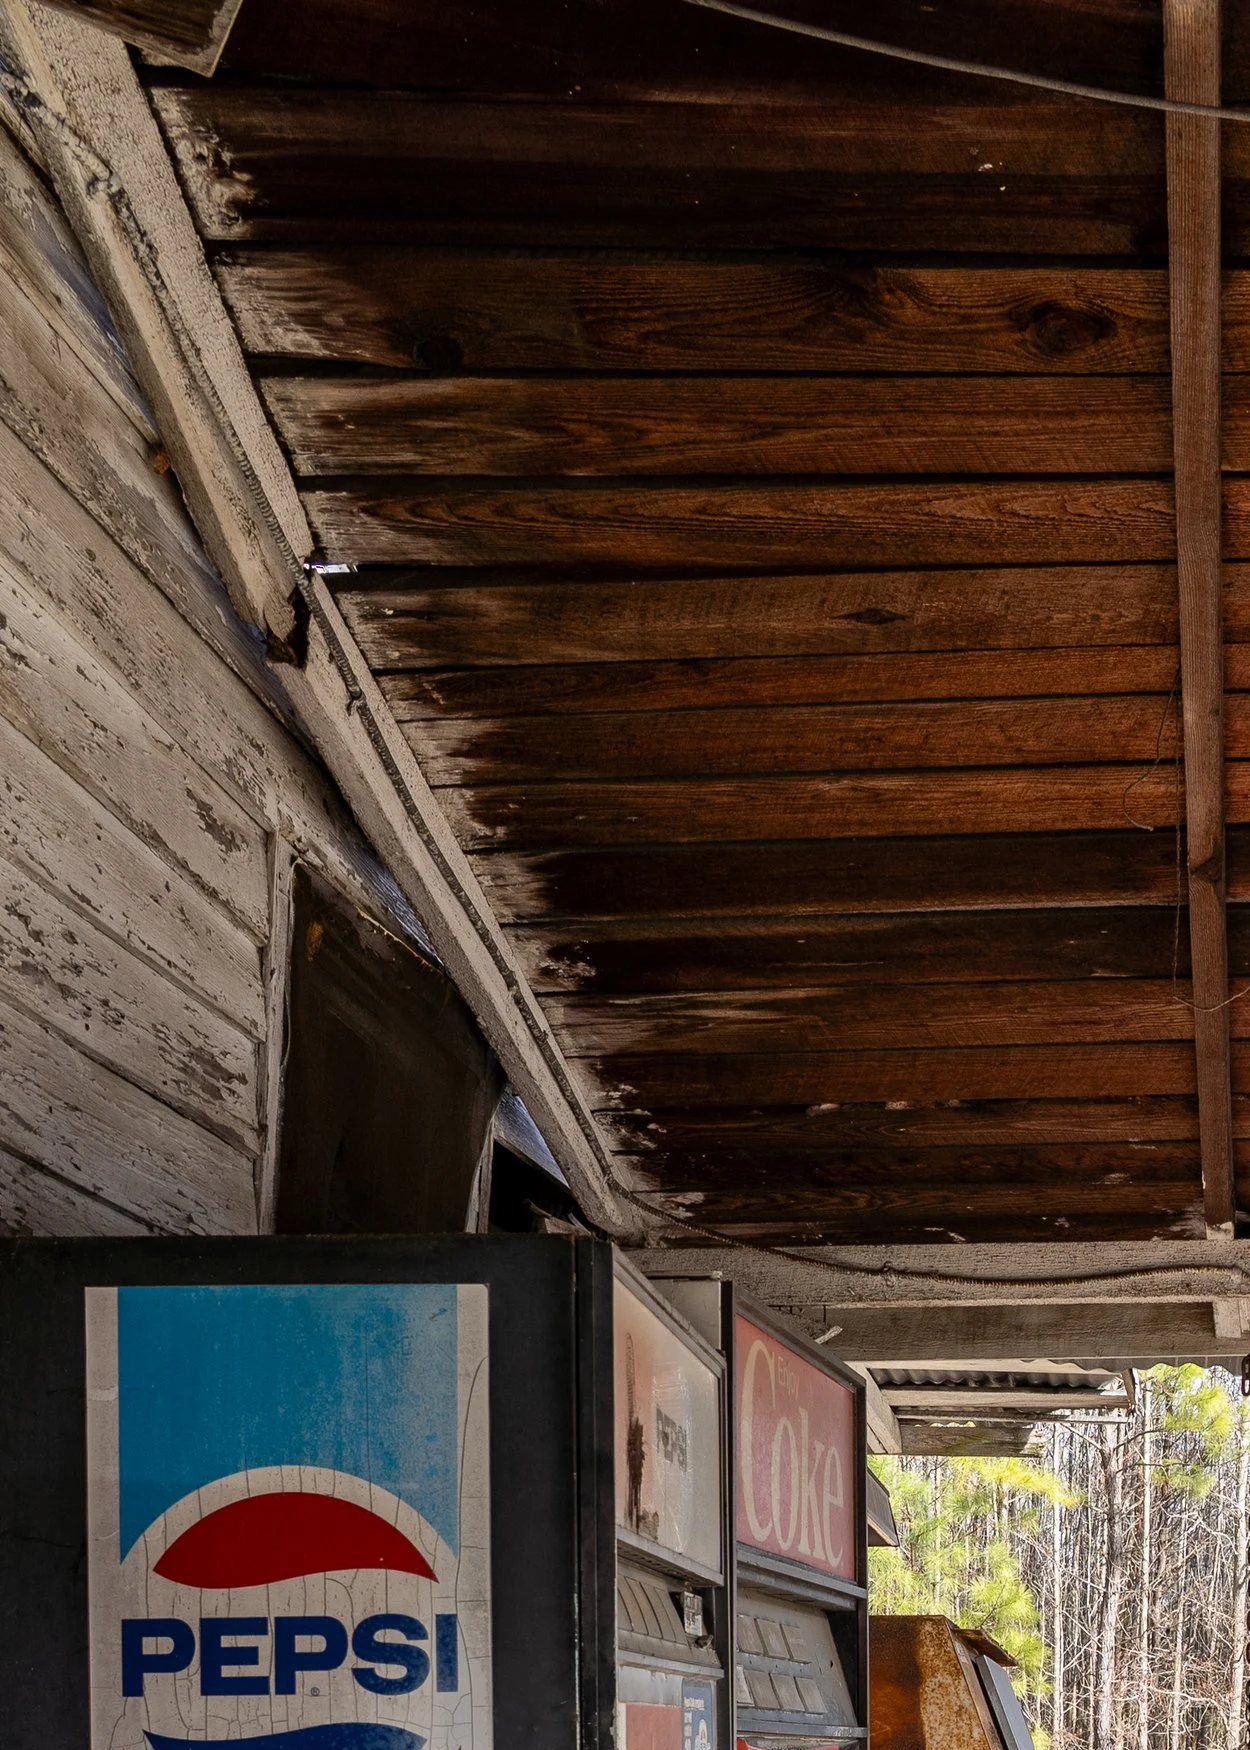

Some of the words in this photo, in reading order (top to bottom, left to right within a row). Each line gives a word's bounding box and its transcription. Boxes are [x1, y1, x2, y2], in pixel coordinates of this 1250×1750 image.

[778, 1354, 800, 1400] Enjoy
[740, 1339, 845, 1569] Coke
[121, 1612, 458, 1698] PEPSI
